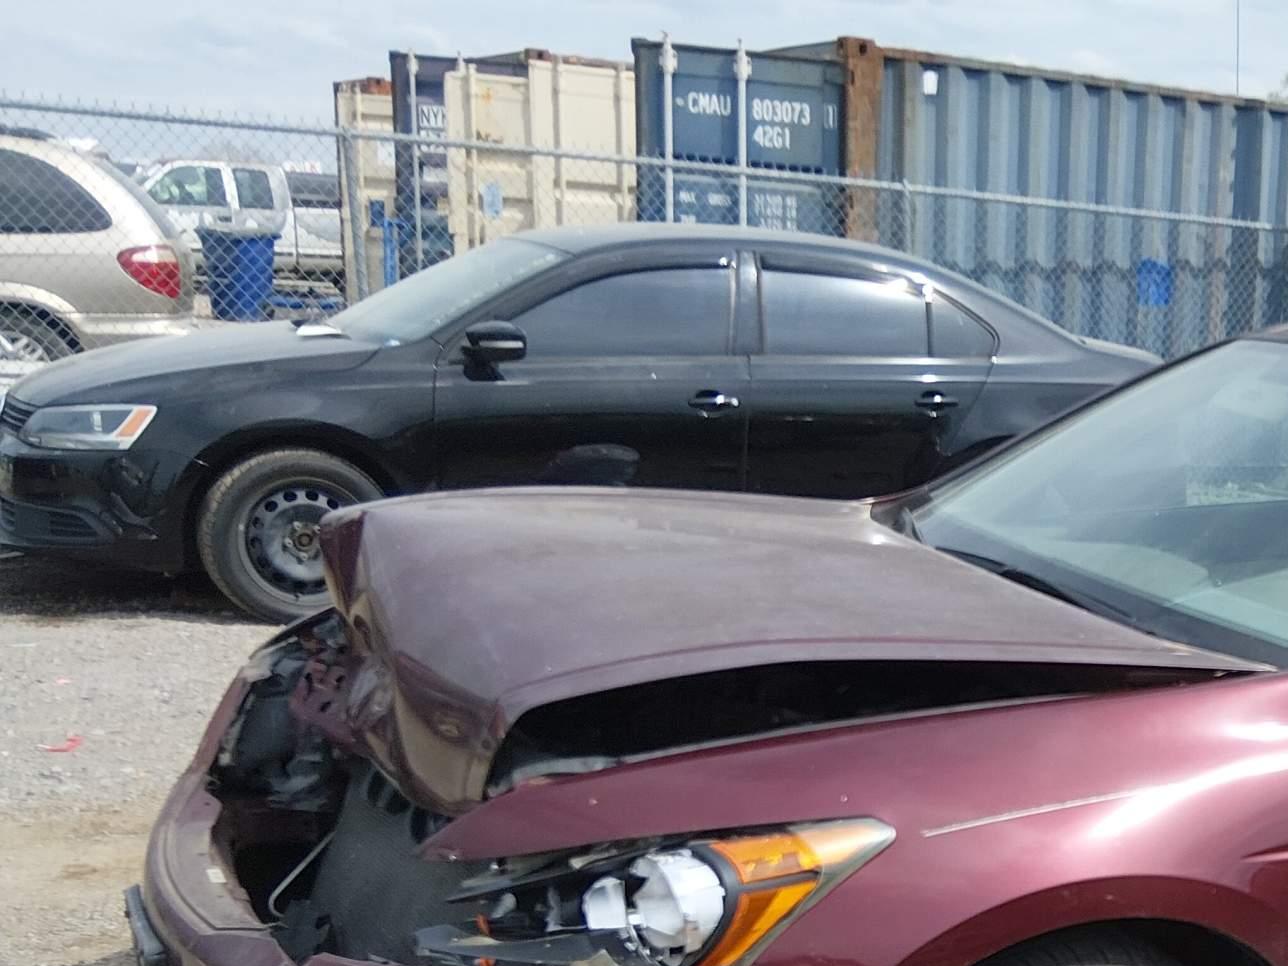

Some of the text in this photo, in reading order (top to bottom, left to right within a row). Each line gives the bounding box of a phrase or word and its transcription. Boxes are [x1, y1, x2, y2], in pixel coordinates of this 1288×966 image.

[687, 92, 732, 116] CMAU
[752, 98, 811, 126] 803073
[753, 125, 791, 149] 42G1
